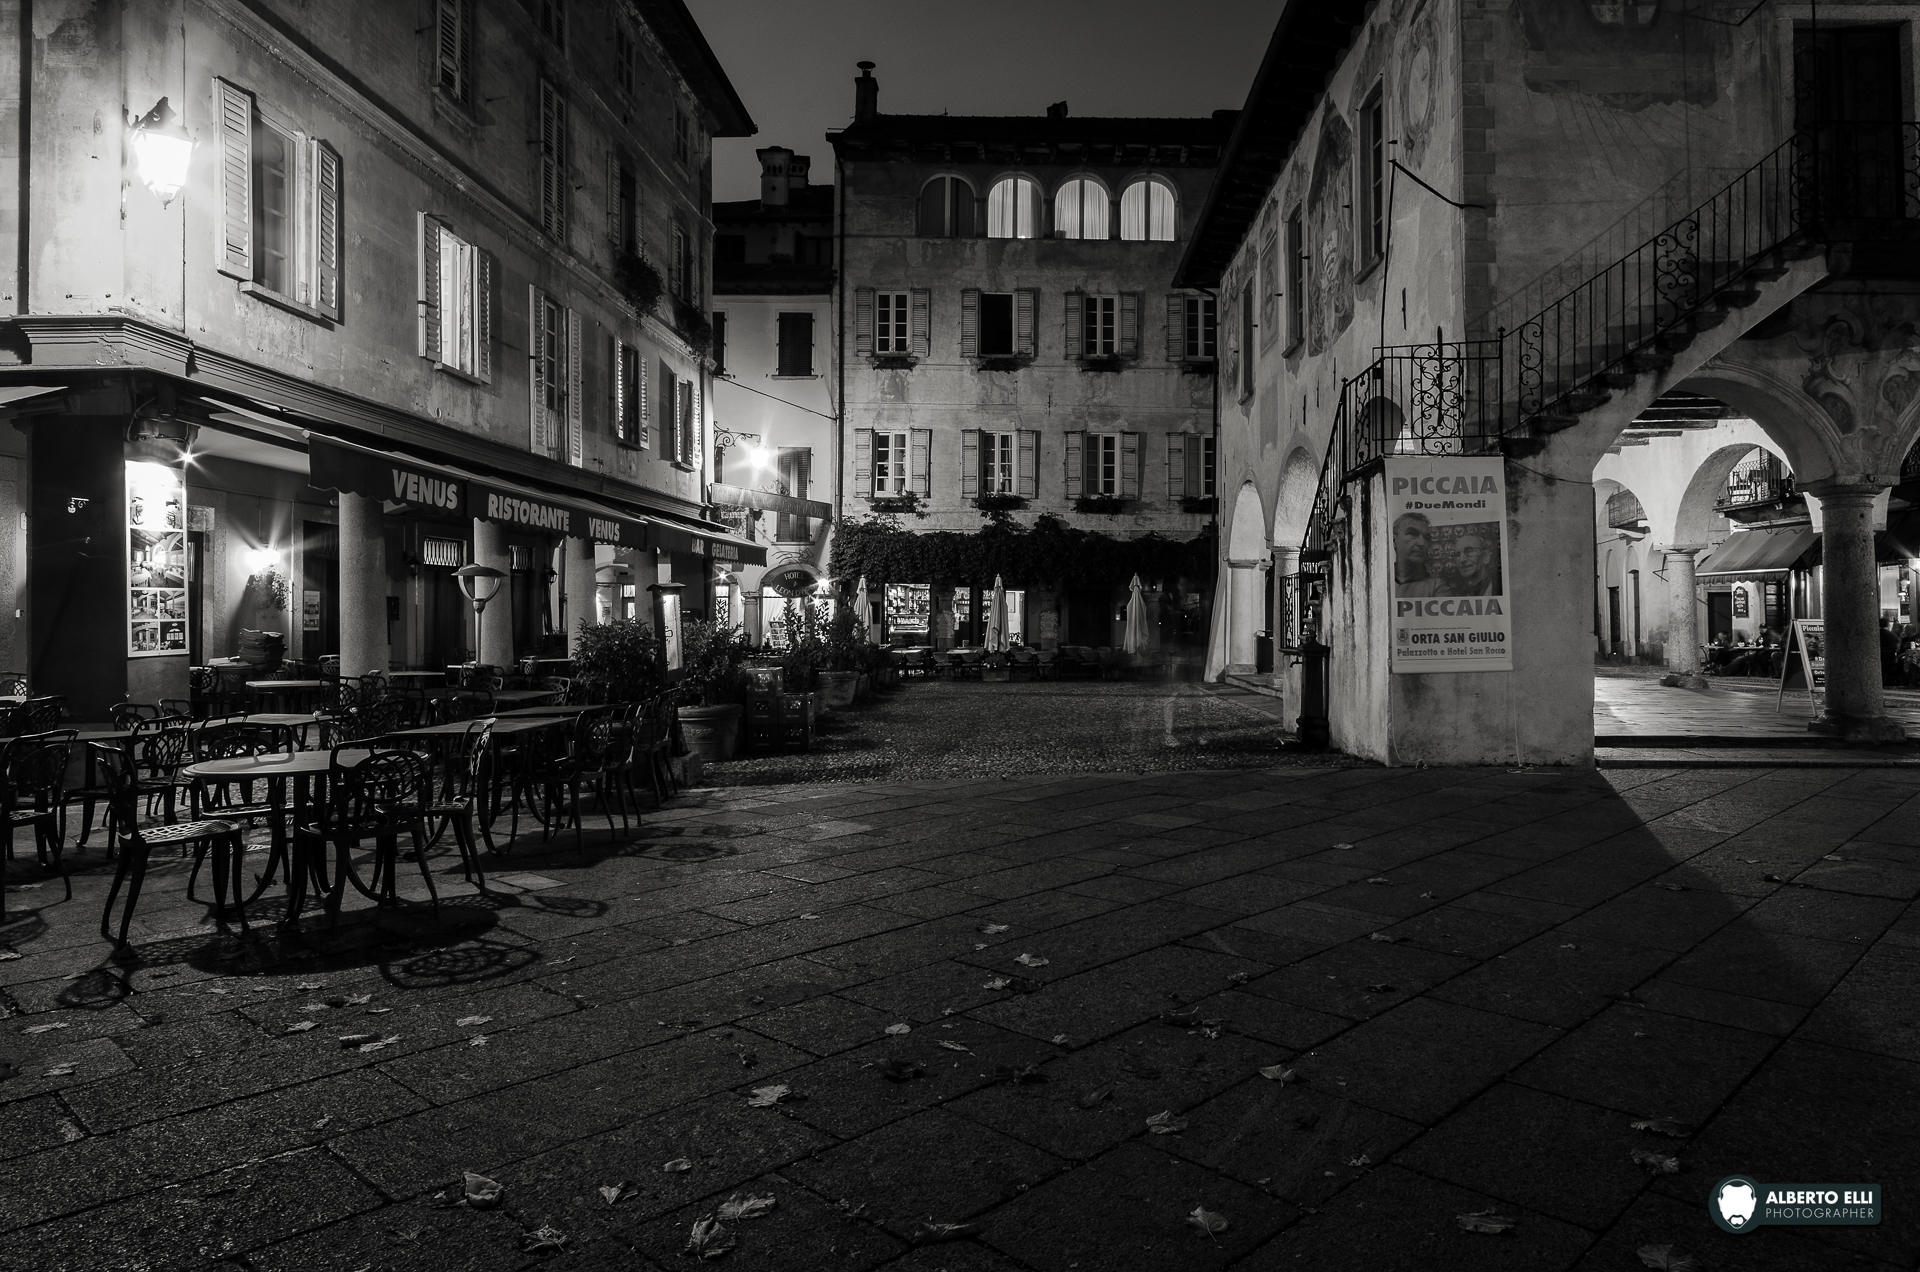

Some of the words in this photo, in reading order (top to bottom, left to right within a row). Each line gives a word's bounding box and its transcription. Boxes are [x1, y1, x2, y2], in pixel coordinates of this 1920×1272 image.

[392, 468, 459, 510] VENUS
[1392, 476, 1499, 496] PICCAIA
[1404, 500, 1487, 510] #DueMondi
[487, 492, 570, 532] RISTORANTE
[588, 516, 620, 542] VENUS
[691, 538, 705, 555] BAR
[711, 542, 739, 561] GELATERIA
[783, 571, 805, 580] HOTEL
[775, 584, 794, 597] LEON
[1396, 599, 1504, 618] PICCAIA
[1411, 633, 1441, 645] ORTA
[1443, 632, 1466, 644] SAN
[1468, 631, 1506, 643] GIULIO
[1396, 647, 1438, 657] Palazzotto
[1447, 646, 1468, 656] Hotel
[1469, 646, 1483, 655] San
[1485, 646, 1507, 655] Rocco
